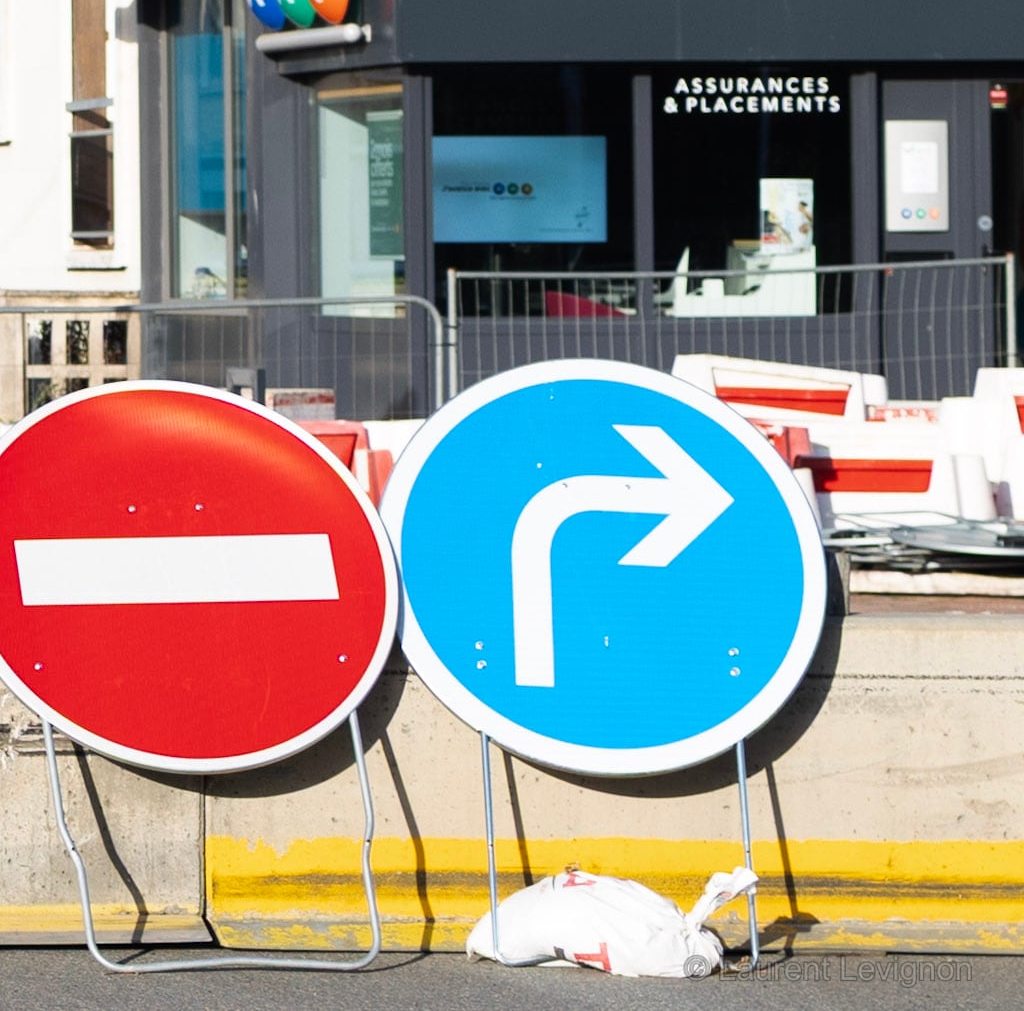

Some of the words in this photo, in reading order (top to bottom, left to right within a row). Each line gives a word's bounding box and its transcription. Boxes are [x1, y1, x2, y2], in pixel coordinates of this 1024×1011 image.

[674, 77, 829, 94] ASSURANCES
[663, 96, 679, 114] &
[685, 96, 841, 113] PLACEMENTS
